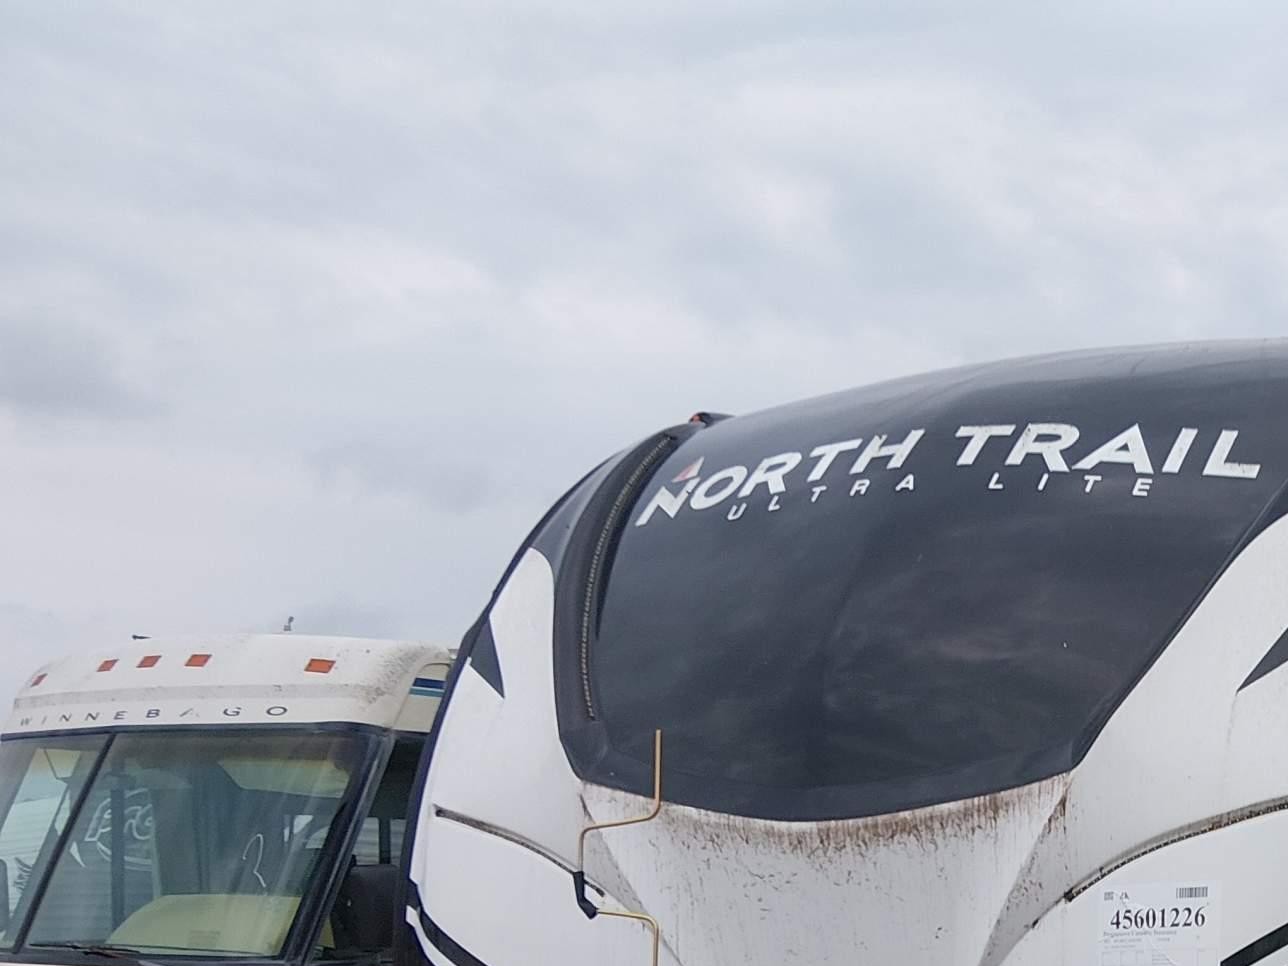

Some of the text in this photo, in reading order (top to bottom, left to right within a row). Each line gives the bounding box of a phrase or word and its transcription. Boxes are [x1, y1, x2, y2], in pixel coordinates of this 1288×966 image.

[635, 422, 1262, 527] NORTH TRAIL
[727, 471, 1153, 521] ULTRA LITE
[1110, 905, 1206, 930] 45601226
